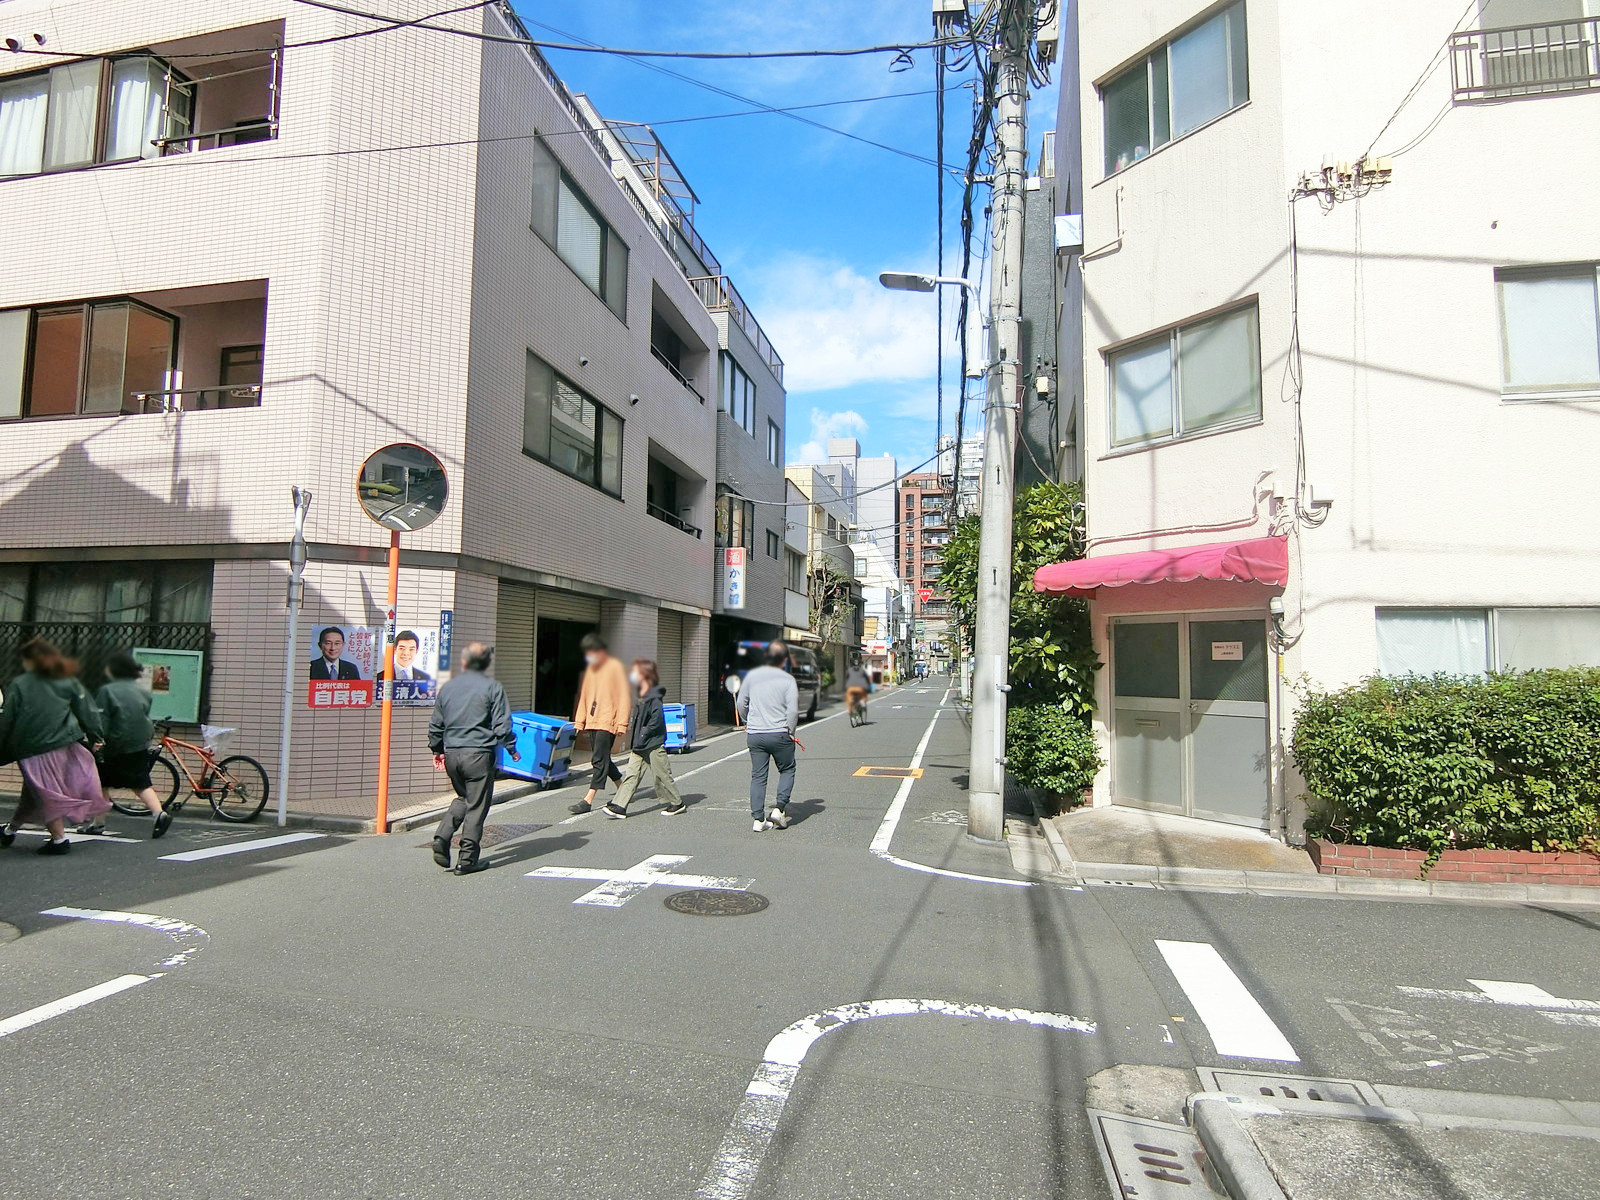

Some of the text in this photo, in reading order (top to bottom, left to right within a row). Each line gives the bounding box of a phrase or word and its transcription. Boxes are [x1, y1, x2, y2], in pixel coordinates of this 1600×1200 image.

[347, 632, 356, 656] ともに。
[386, 623, 396, 643] 注意
[355, 632, 363, 660] 皆さんと
[362, 632, 372, 674] 新しい時代を
[314, 690, 368, 705] 自民党
[395, 687, 422, 699] 清人
